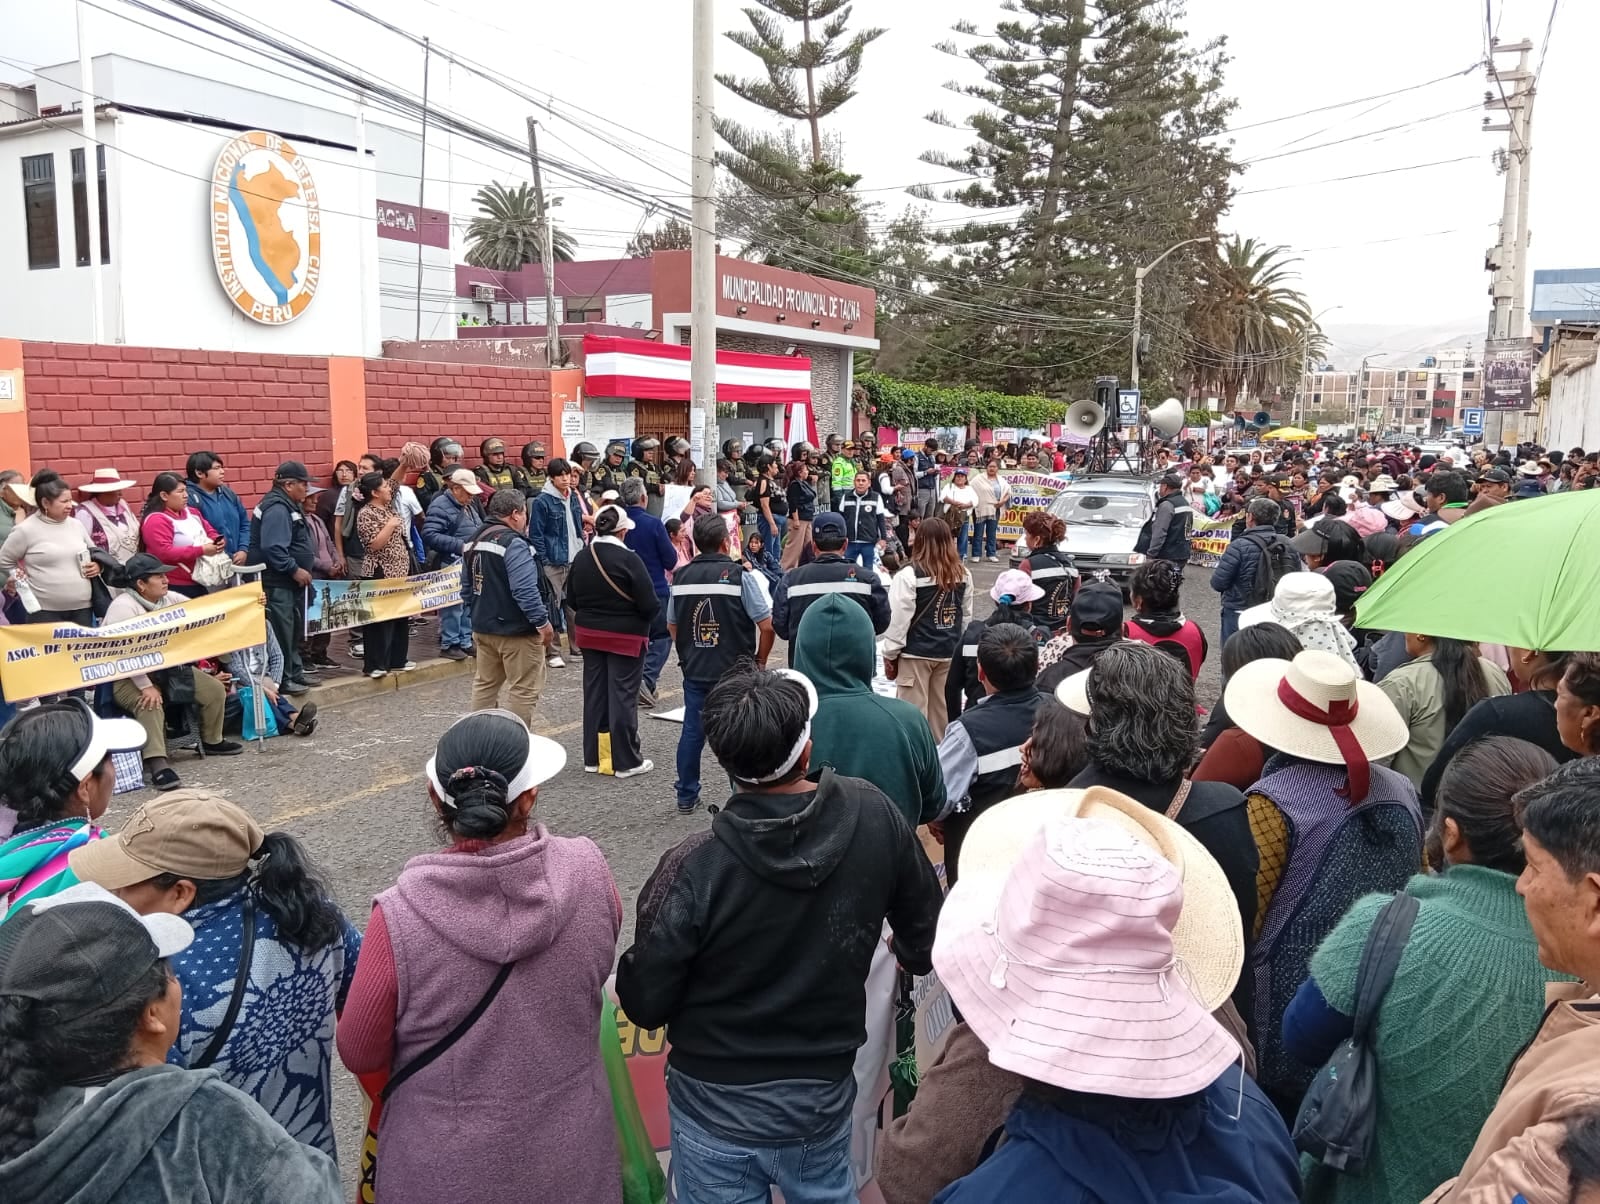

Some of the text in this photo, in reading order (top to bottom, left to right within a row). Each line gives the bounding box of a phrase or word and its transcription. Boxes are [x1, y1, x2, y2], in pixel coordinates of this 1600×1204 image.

[214, 134, 320, 298] INSTITUTO NACIONAL DE DEFENSA CIVIL
[722, 274, 861, 321] MUNICIPALIDAD PROVINCIAL DE TACNA
[1468, 413, 1479, 425] E
[1037, 476, 1067, 491] TACNA
[159, 607, 187, 623] GRAU
[7, 612, 226, 662] ASOC. DE VERDURAS PUERTA ABIERTA
[80, 651, 165, 682] FUNDO CHOLOLO
